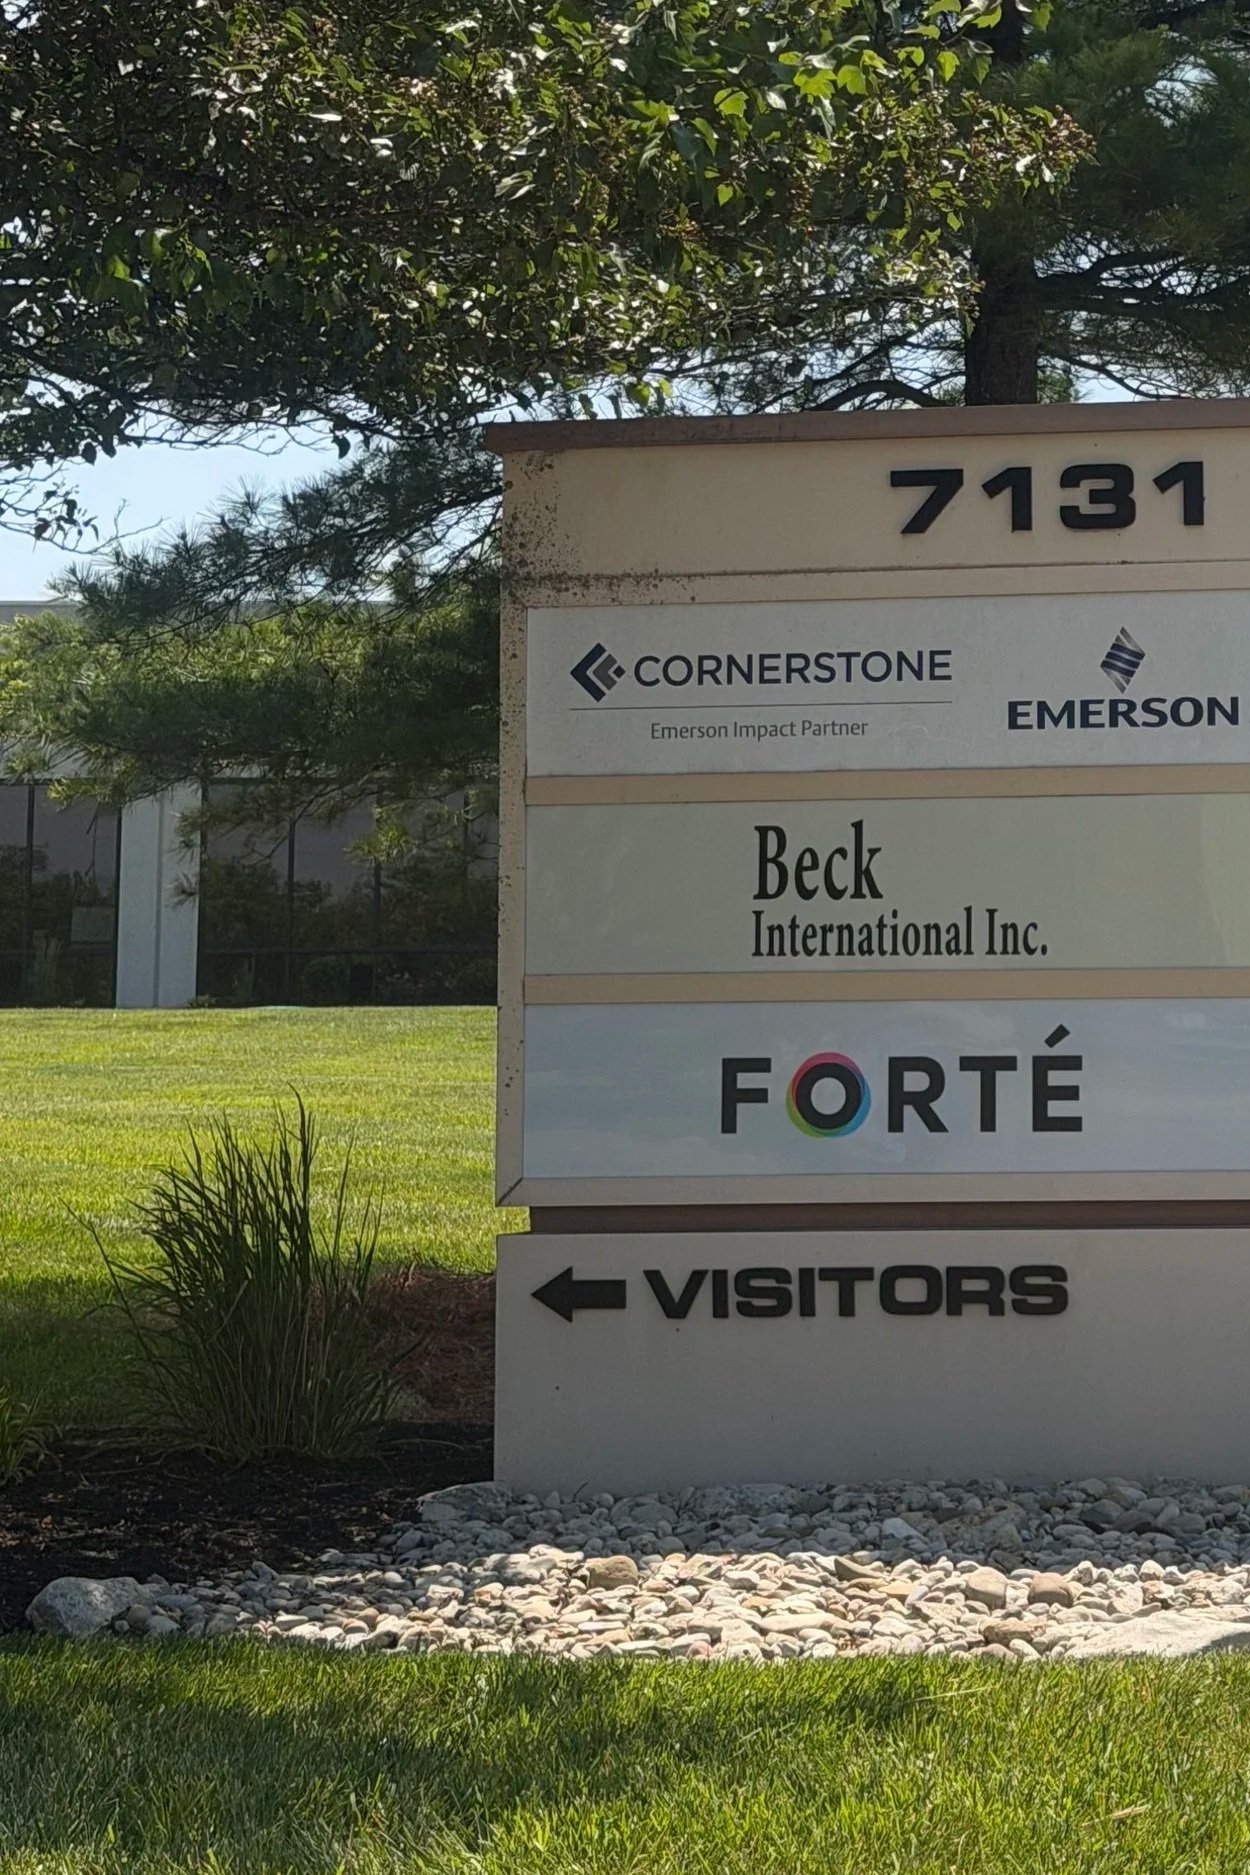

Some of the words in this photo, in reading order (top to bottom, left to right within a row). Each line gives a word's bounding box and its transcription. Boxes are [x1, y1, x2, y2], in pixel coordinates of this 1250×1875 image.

[890, 461, 1205, 534] 7131
[633, 649, 953, 687] CORNERSTONE
[651, 722, 729, 740] Emerson
[734, 721, 797, 743] Impact
[801, 719, 869, 737] Partner
[1008, 695, 1239, 730] EMERSON
[752, 819, 884, 901] Beck
[751, 906, 974, 957] International
[985, 908, 1048, 956] Inc.
[721, 1024, 1083, 1137] FORTÉ
[643, 1265, 1069, 1320] VISITORS
